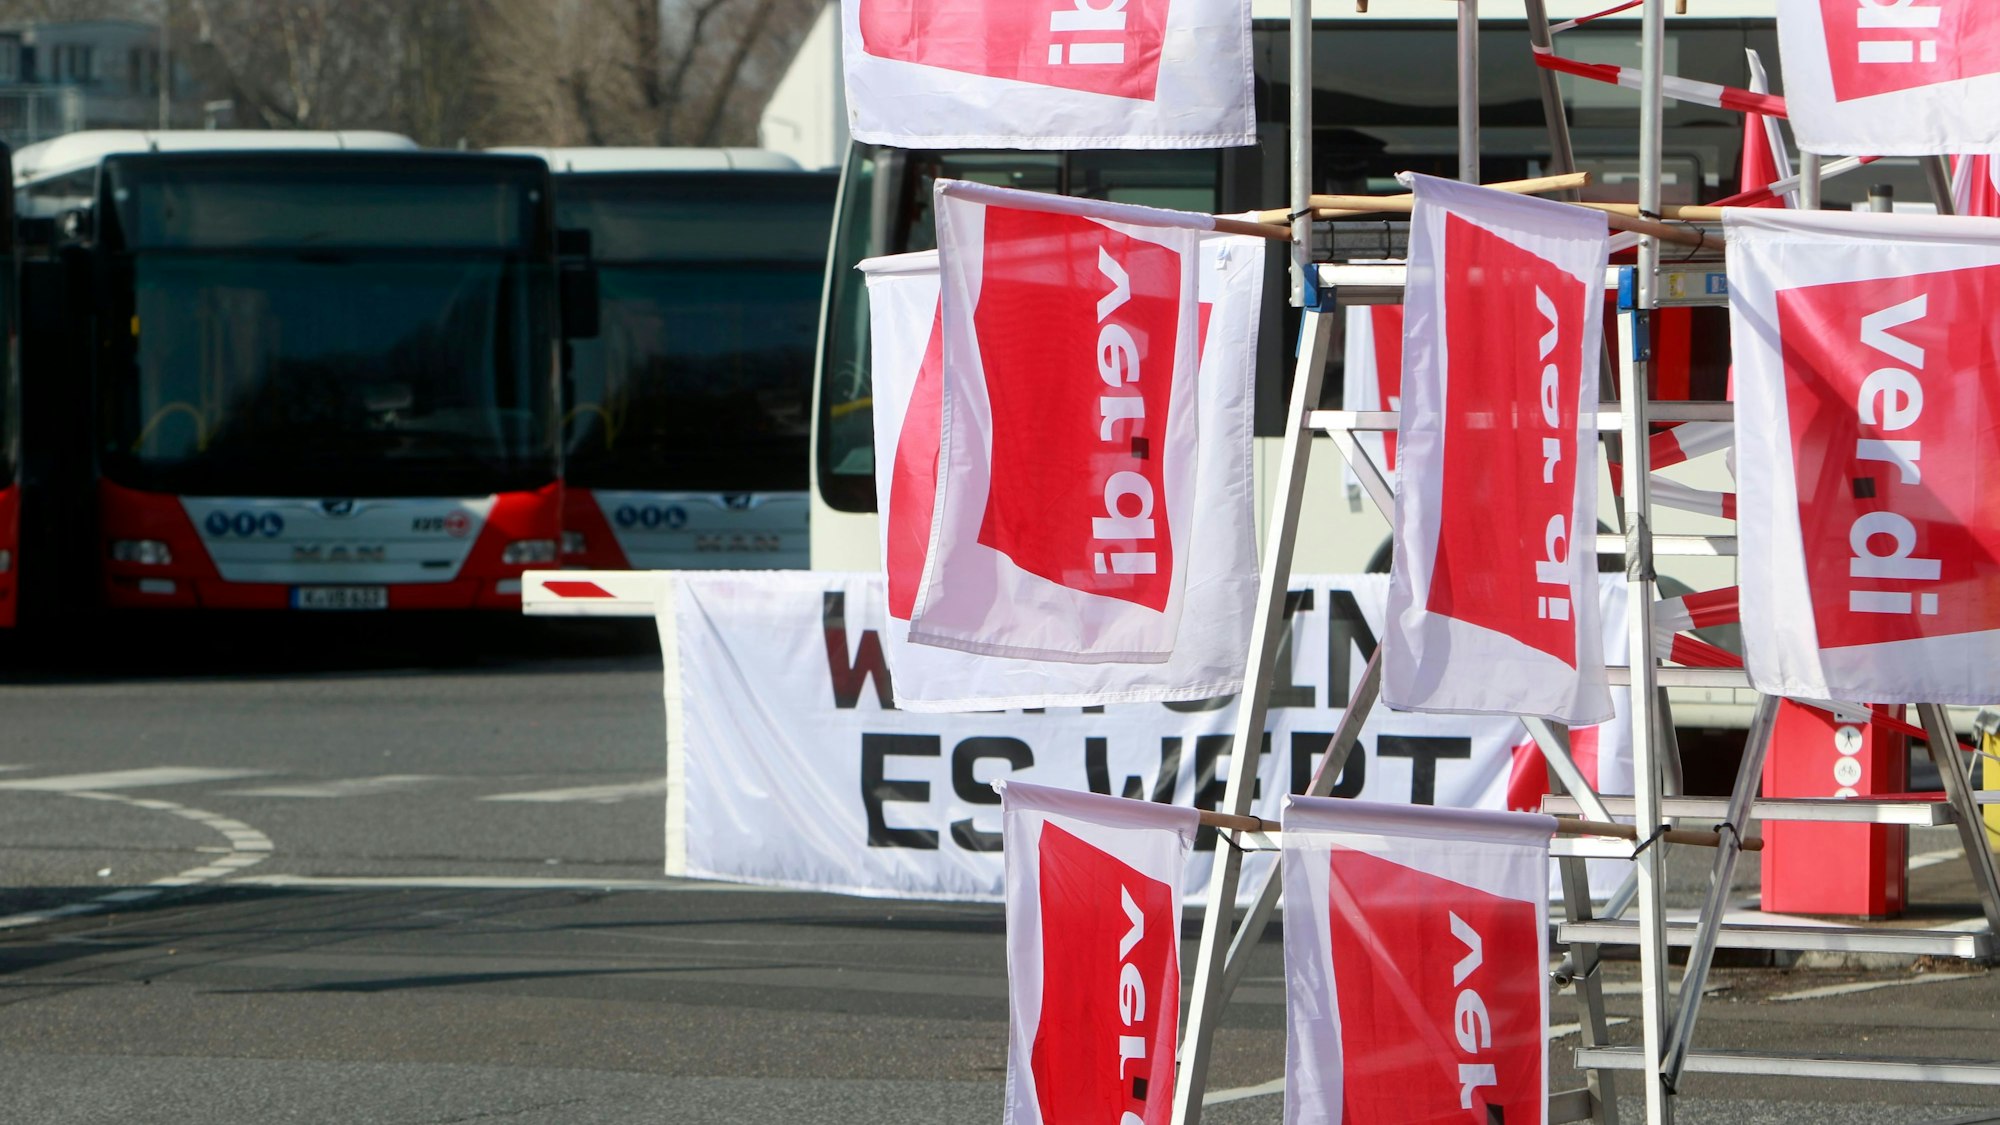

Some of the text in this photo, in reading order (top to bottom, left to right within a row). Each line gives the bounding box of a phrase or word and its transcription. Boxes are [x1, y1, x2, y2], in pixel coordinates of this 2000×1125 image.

[1849, 293, 1942, 615] ver.di
[293, 545, 385, 564] MAN
[861, 732, 1034, 853] ES
